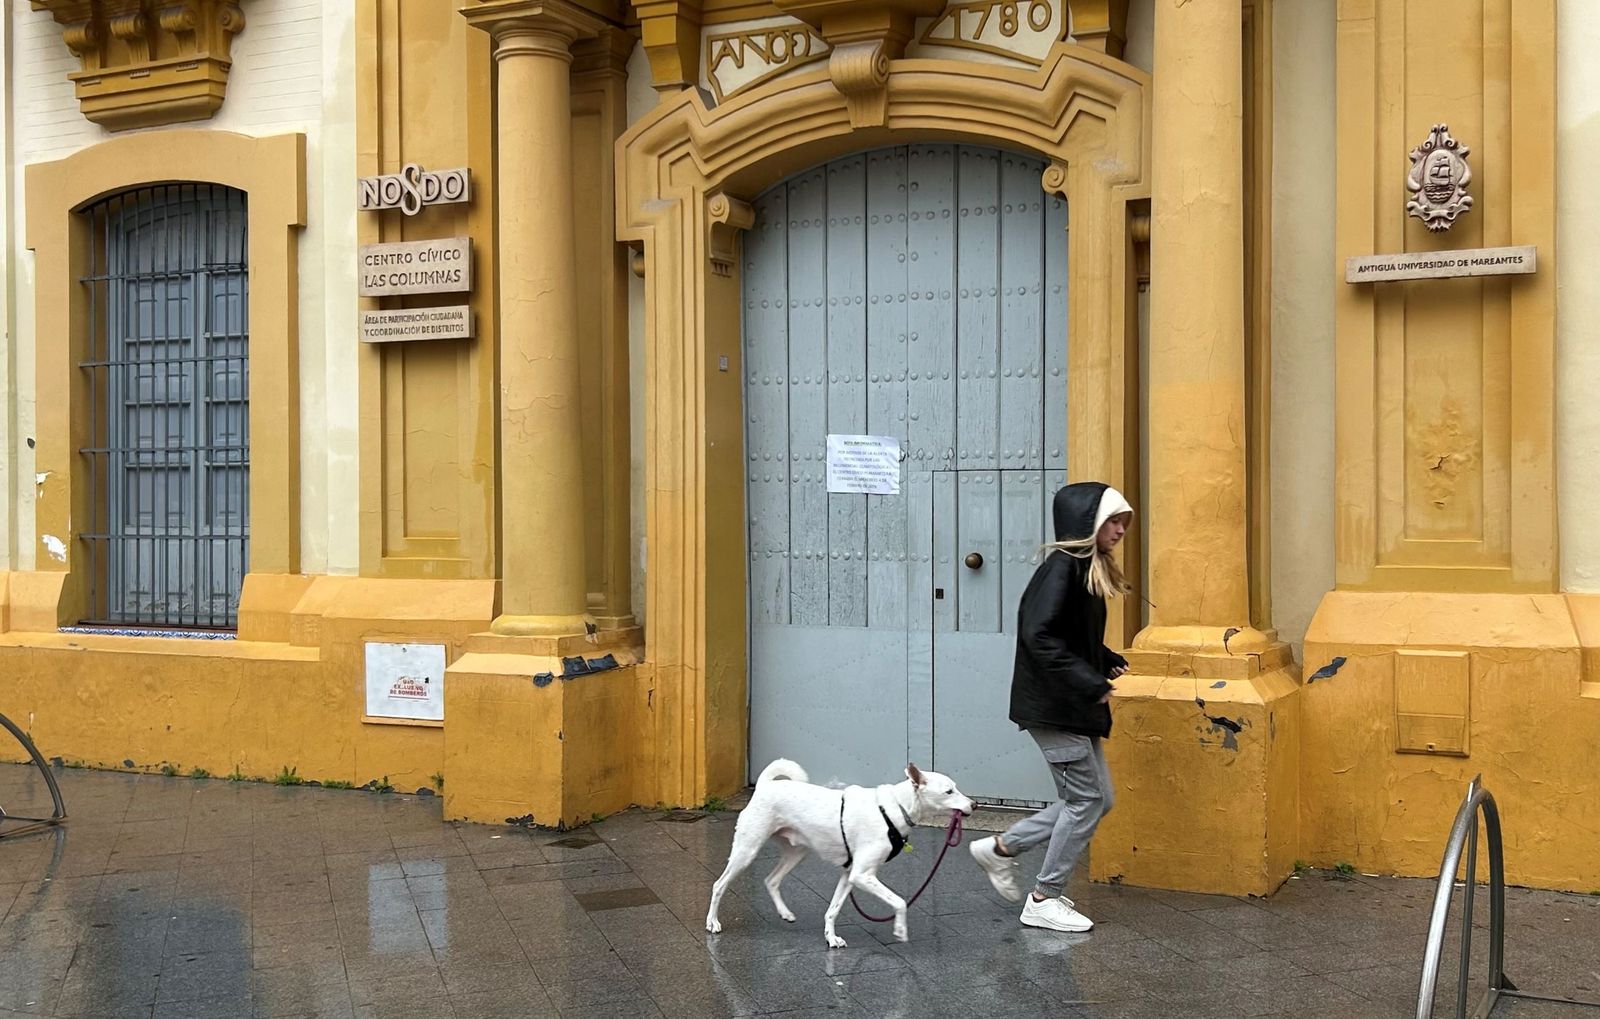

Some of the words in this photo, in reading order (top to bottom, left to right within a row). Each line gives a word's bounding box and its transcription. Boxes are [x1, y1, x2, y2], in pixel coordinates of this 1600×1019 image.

[950, 0, 1053, 41] 1780
[364, 252, 413, 266] CENTRO
[418, 248, 461, 262] CÍVICO
[1357, 263, 1396, 273] ANTIGUA
[1397, 260, 1455, 270] UNIVERSIDAD
[1457, 259, 1469, 267] DE
[1470, 256, 1524, 266] MAREANTES
[364, 274, 386, 288] LAS
[388, 269, 461, 286] COLUMNAS
[380, 316, 388, 324] DE
[388, 312, 430, 323] PARTICIPACIÓN
[430, 312, 464, 321] CIUDADANA
[370, 326, 421, 337] COORDINACIÓN
[431, 324, 464, 333] DISTRITOS
